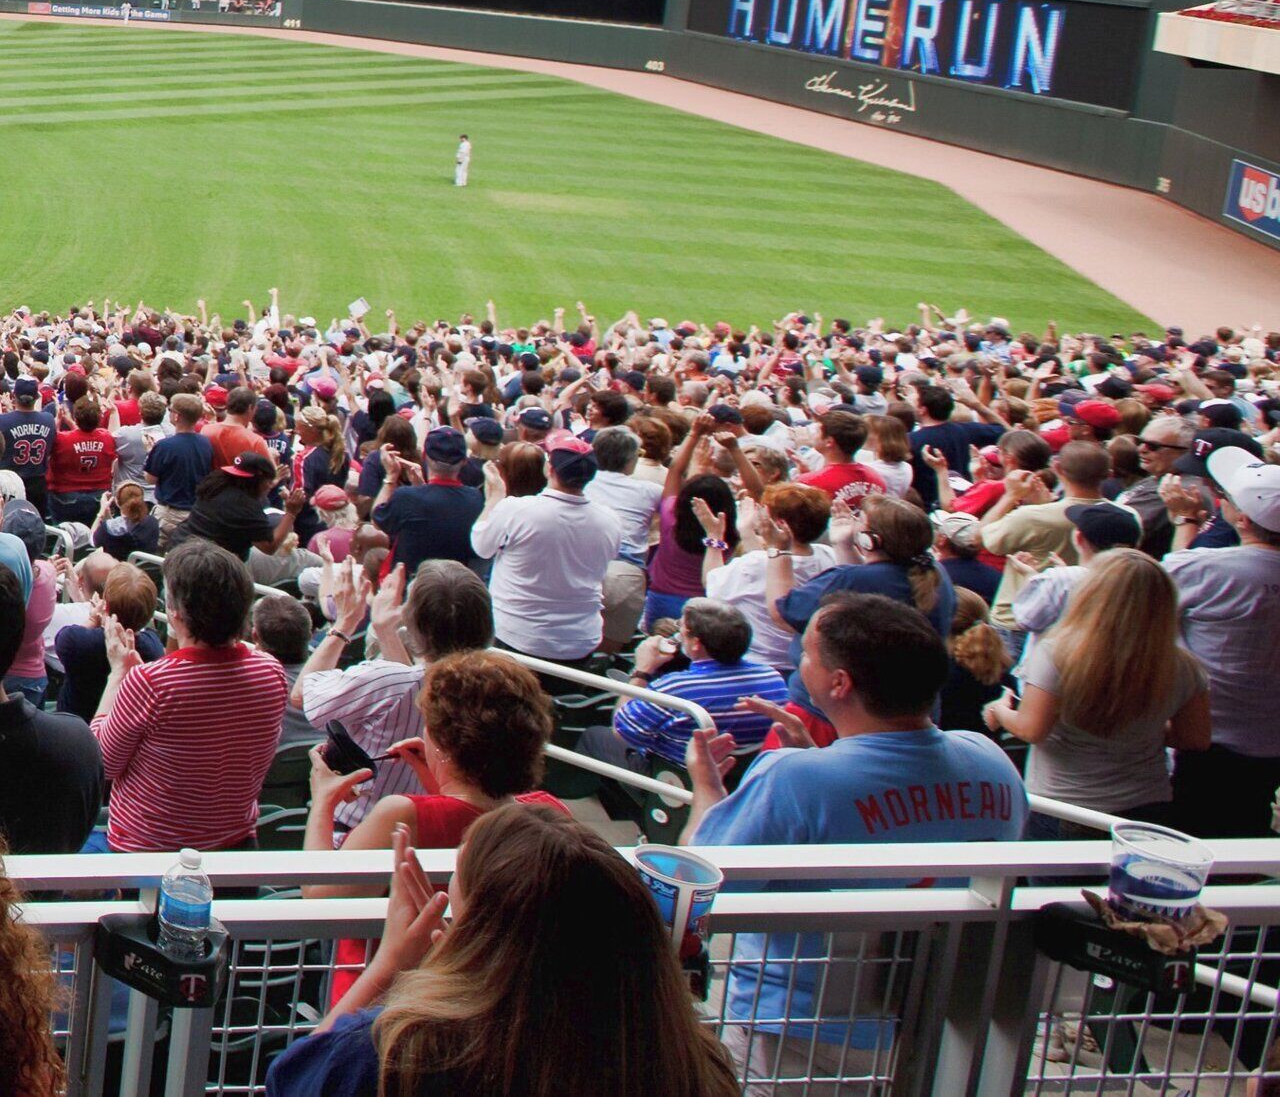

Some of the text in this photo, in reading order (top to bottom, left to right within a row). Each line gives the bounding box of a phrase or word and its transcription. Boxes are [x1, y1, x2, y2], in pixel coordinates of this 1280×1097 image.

[52, 5, 80, 15] Getting
[81, 5, 100, 15] More
[102, 6, 120, 16] Kids
[130, 8, 143, 17] the
[144, 10, 168, 19] Game
[283, 19, 301, 28] 411
[10, 423, 50, 439] MORNEAU
[13, 439, 47, 466] 33
[73, 440, 104, 454] MAUER
[80, 455, 98, 472] 7
[855, 781, 1013, 835] MORNEAU
[180, 973, 207, 1002] T
